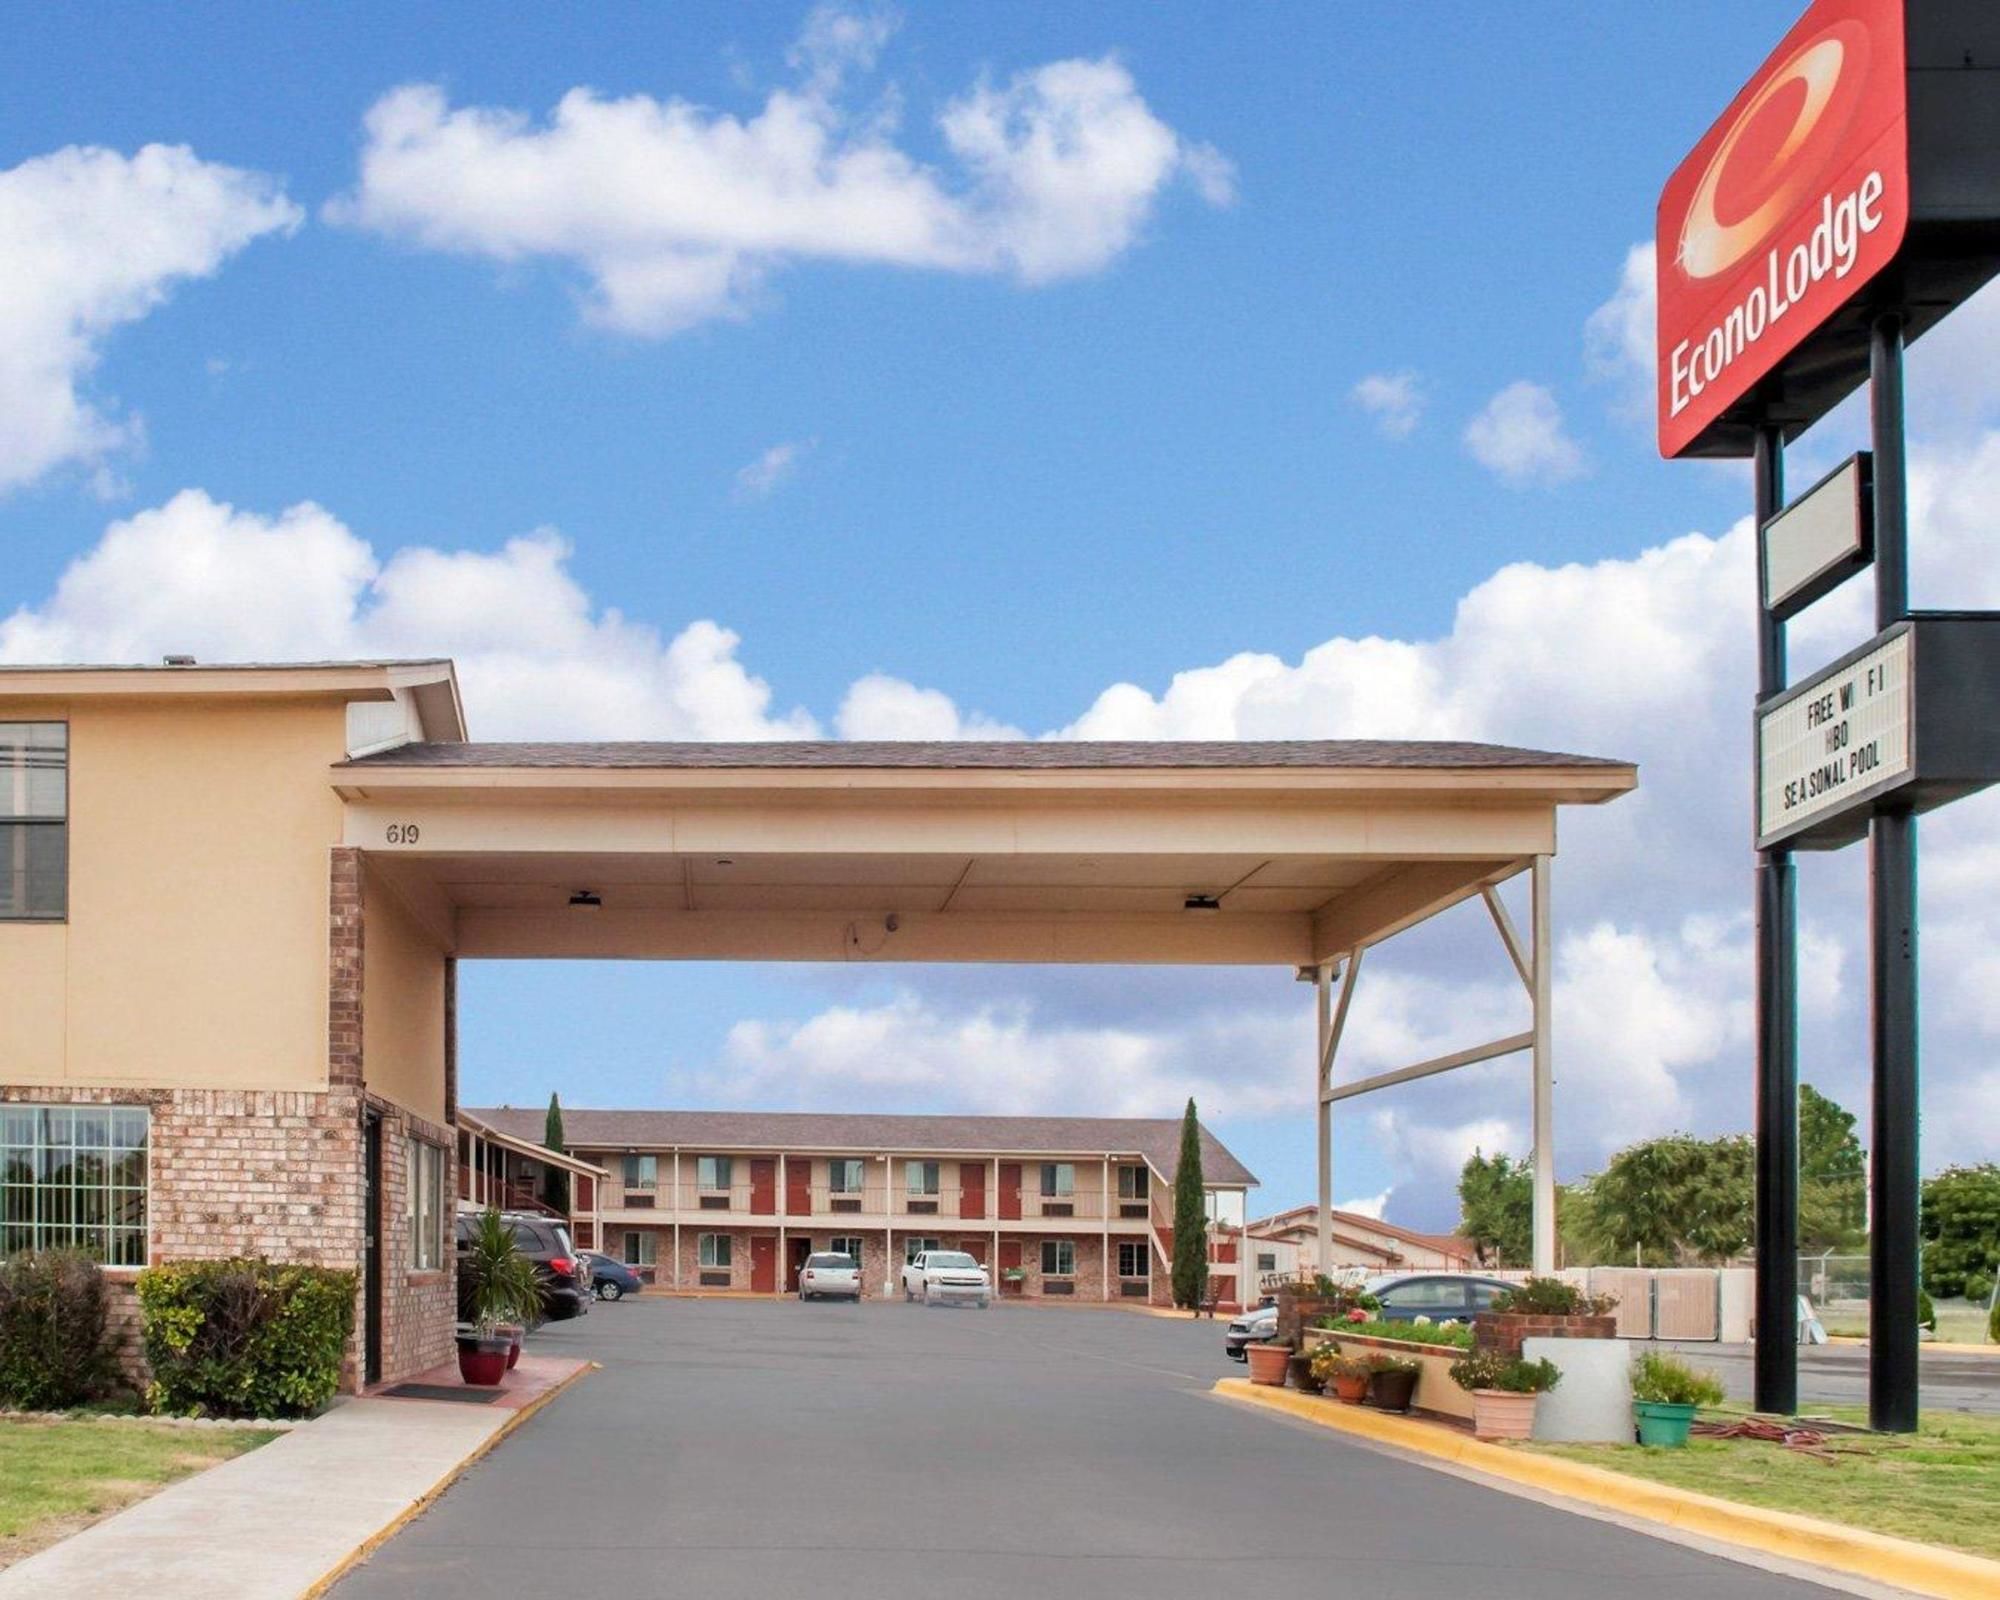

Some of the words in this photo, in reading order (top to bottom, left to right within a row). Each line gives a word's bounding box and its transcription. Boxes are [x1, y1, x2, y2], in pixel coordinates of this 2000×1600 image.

[1670, 170, 1883, 419] EconoLodge
[1807, 692, 1834, 731] FREE
[1825, 720, 1848, 754] HBO
[1850, 740, 1880, 780] POOL
[386, 824, 420, 844] 619
